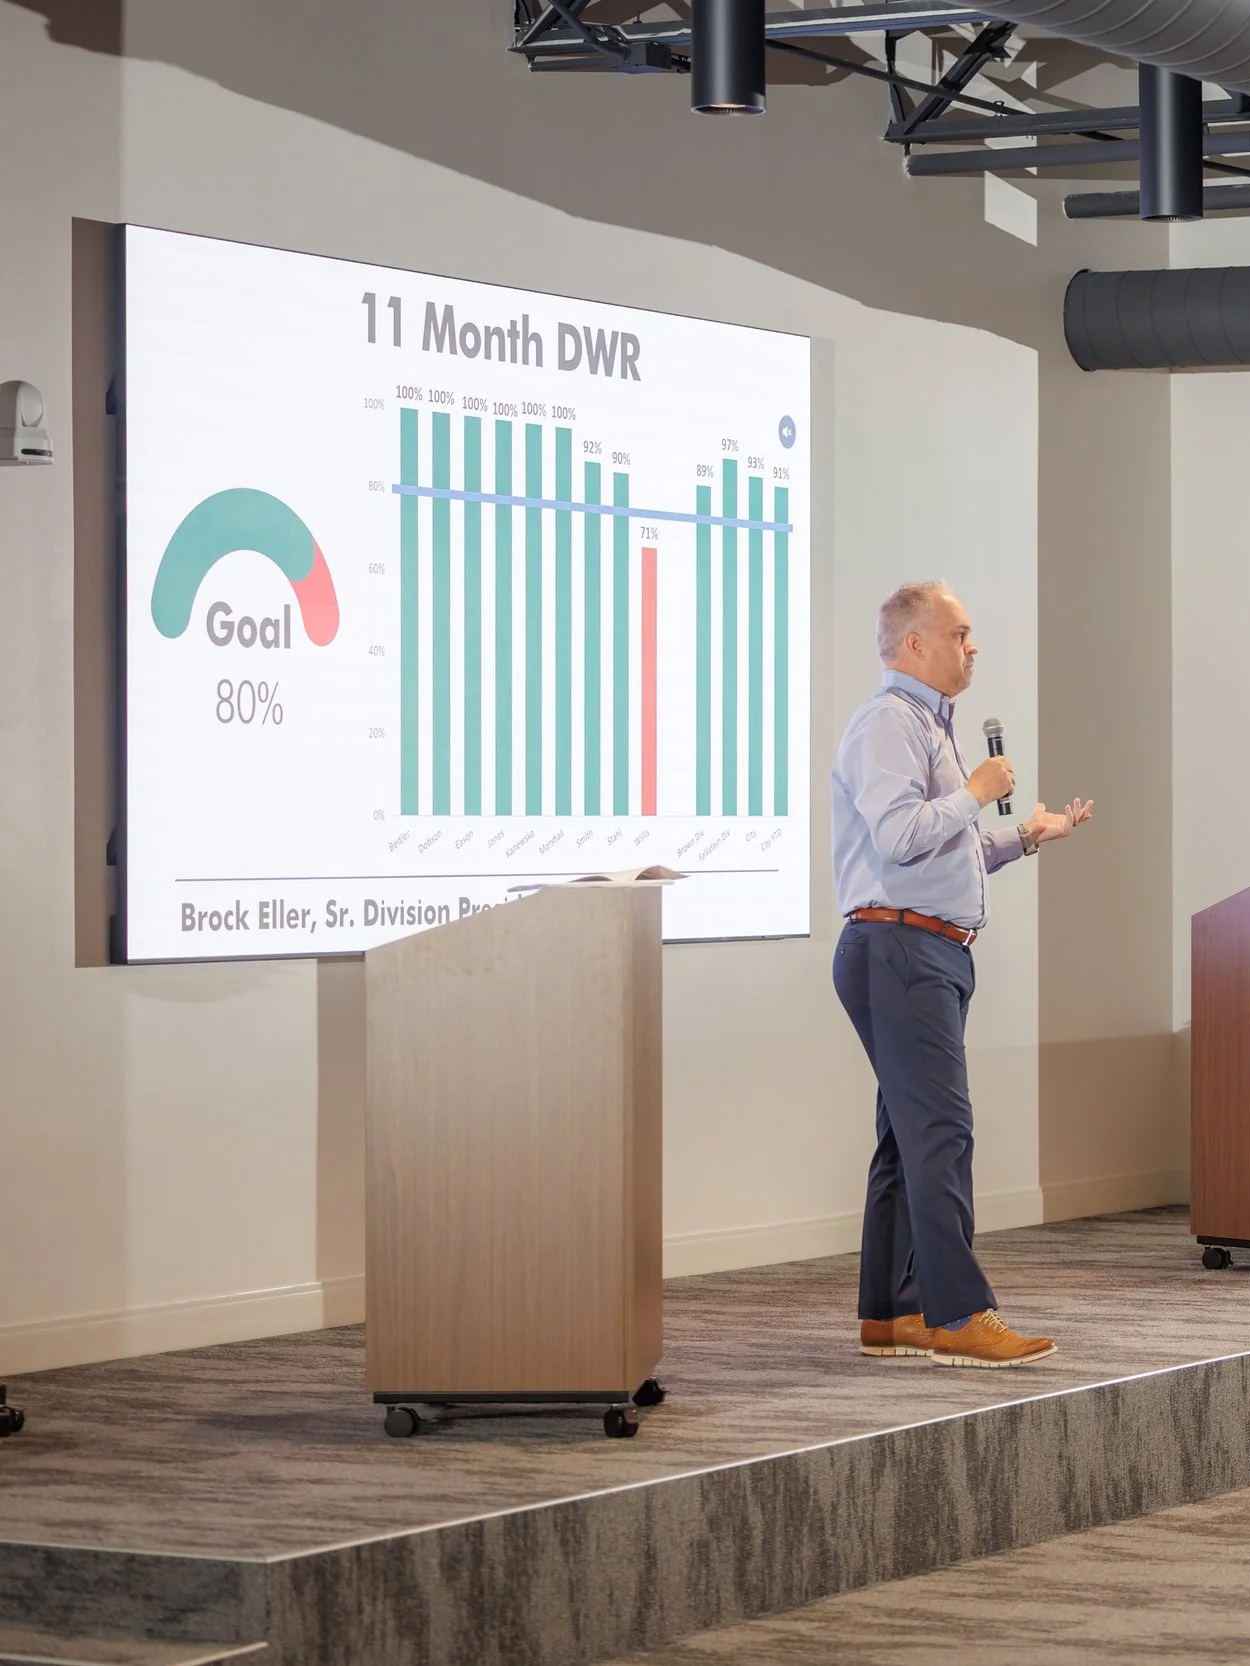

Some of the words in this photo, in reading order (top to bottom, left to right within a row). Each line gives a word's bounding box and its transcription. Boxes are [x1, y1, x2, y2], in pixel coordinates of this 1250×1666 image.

[362, 291, 402, 347] 11
[422, 301, 544, 368] Month
[557, 322, 642, 381] DWR
[396, 385, 423, 401] 100%
[429, 389, 455, 405] 100%
[363, 398, 385, 410] 100%
[462, 396, 488, 412] 100%
[492, 402, 518, 418] 100%
[521, 401, 547, 417] 100%
[551, 405, 577, 420] 100%
[583, 440, 603, 454] 92%
[721, 438, 739, 452] 97%
[612, 451, 631, 466] 90%
[747, 456, 765, 470] 93%
[696, 464, 714, 478] 89%
[773, 466, 790, 480] 91%
[368, 480, 386, 492] 80%
[640, 526, 659, 540] 71%
[368, 562, 386, 575] 60%
[205, 600, 292, 650] Goal
[368, 645, 386, 657] 40%
[215, 678, 284, 726] 80%
[368, 727, 386, 740] 20%
[373, 809, 386, 822] 0%
[417, 830, 443, 855] Dobson
[455, 830, 474, 850] Eason
[487, 829, 505, 849] Jones
[538, 827, 565, 855] Marshall
[576, 829, 593, 848] Smith
[606, 827, 622, 846] Stahl
[676, 838, 696, 858] Brown
[181, 899, 250, 932] Brock
[258, 898, 317, 934] Eller,
[325, 899, 355, 929] Sr.
[363, 898, 450, 928] Division
